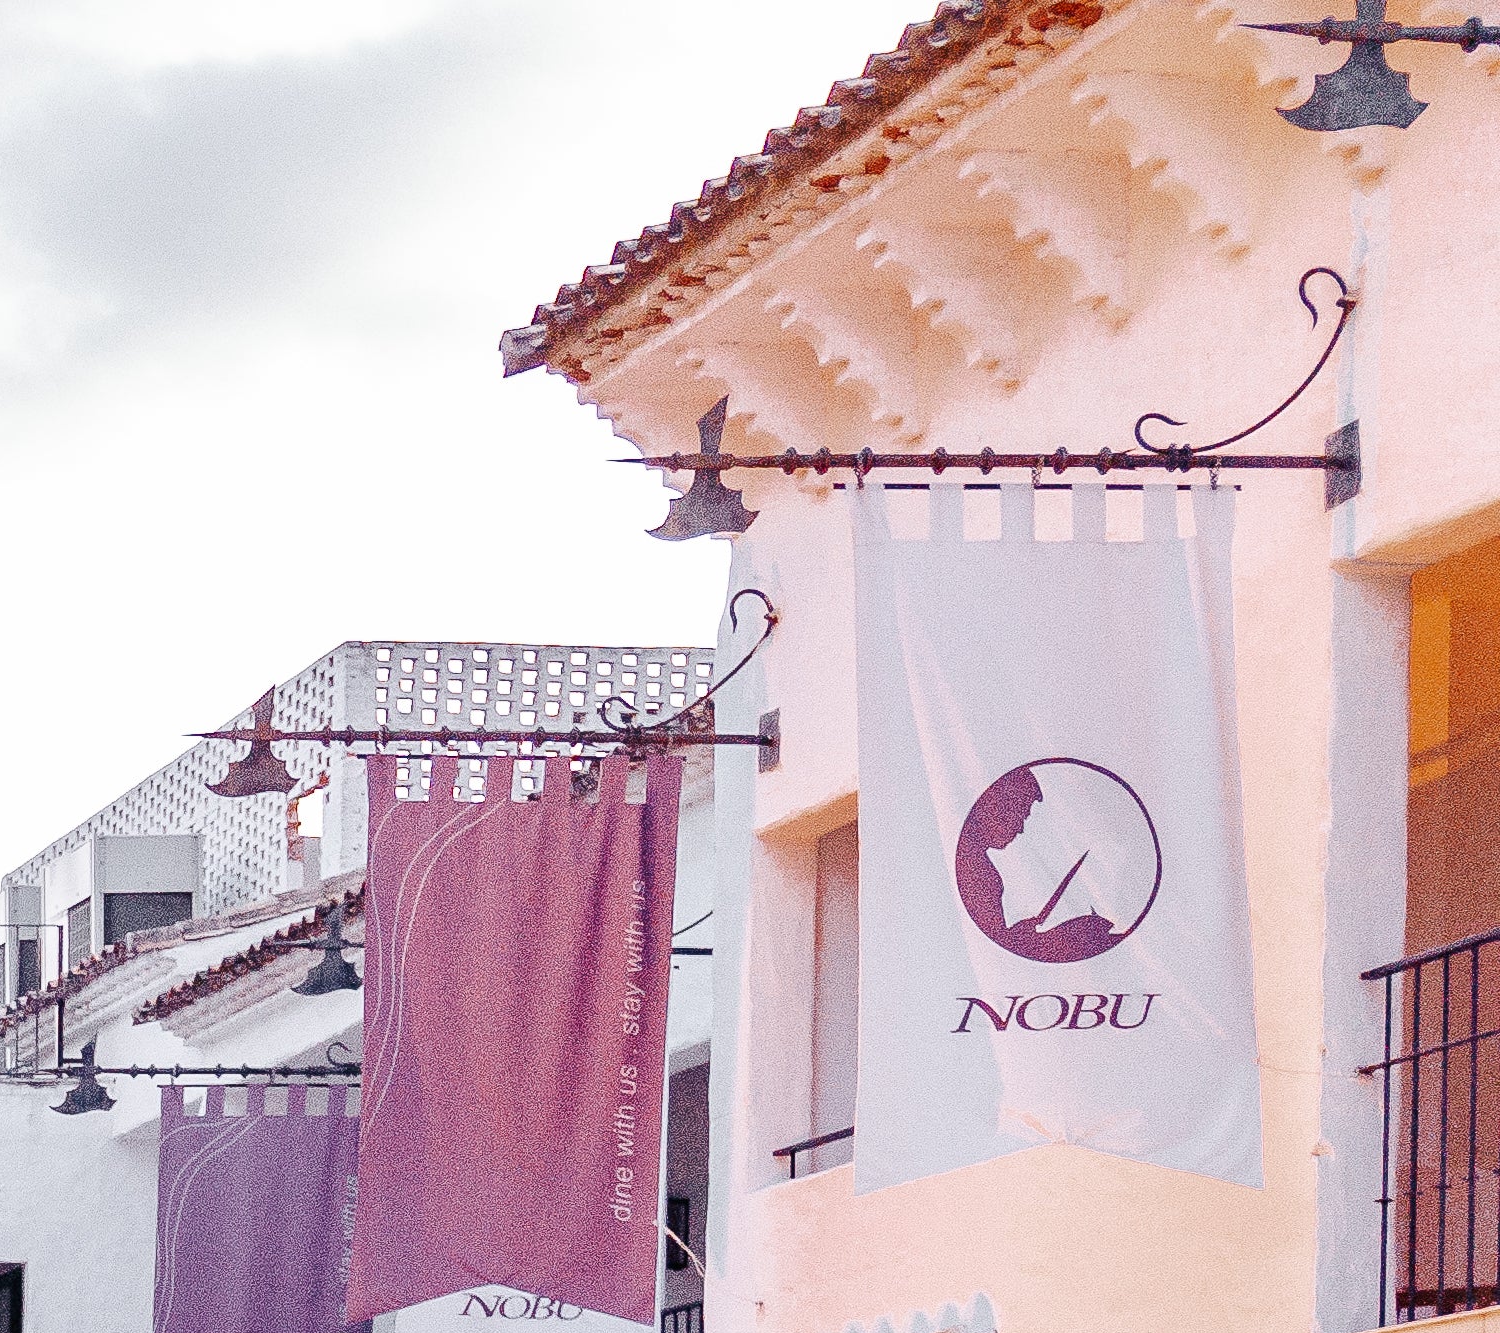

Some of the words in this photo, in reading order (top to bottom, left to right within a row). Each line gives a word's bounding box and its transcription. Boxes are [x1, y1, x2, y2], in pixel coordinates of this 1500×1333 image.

[629, 871, 645, 908] us
[621, 916, 641, 975] with
[619, 982, 644, 1038] stay
[951, 993, 1160, 1034] NOBU
[618, 1063, 638, 1097] us
[610, 1103, 635, 1159] with
[608, 1166, 633, 1223] dine
[458, 1293, 582, 1320] NOBU
